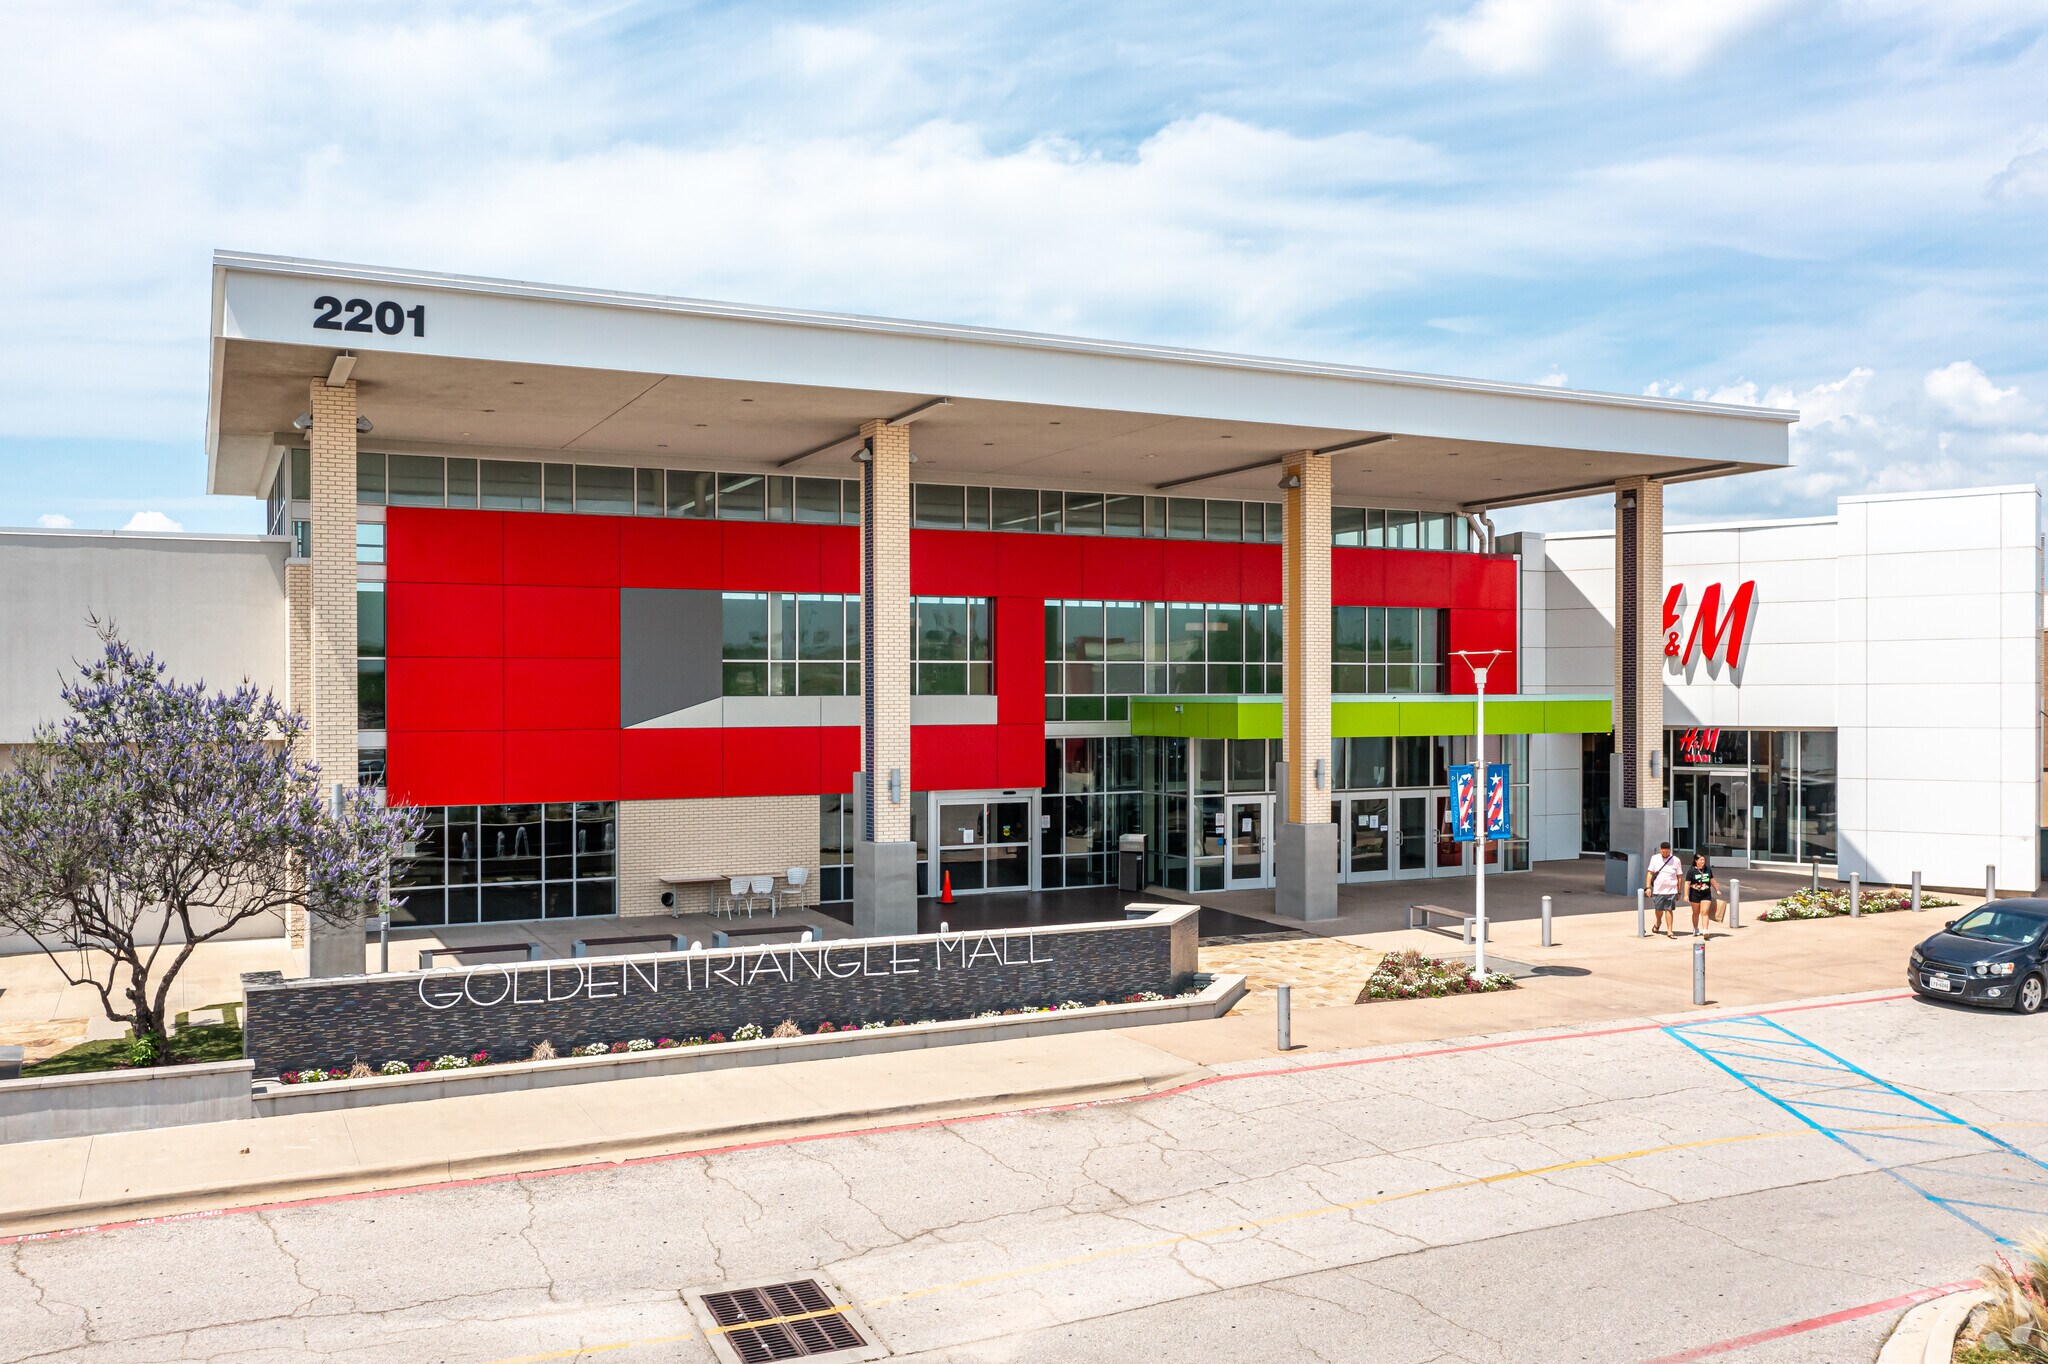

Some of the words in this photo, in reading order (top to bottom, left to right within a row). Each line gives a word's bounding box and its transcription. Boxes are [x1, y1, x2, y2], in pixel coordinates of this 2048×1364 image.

[313, 296, 425, 337] 2201
[1679, 727, 1720, 753] H&M
[419, 951, 659, 1009] GOLDEN
[681, 937, 920, 991] TRIANGLE
[936, 927, 1054, 971] MALL
